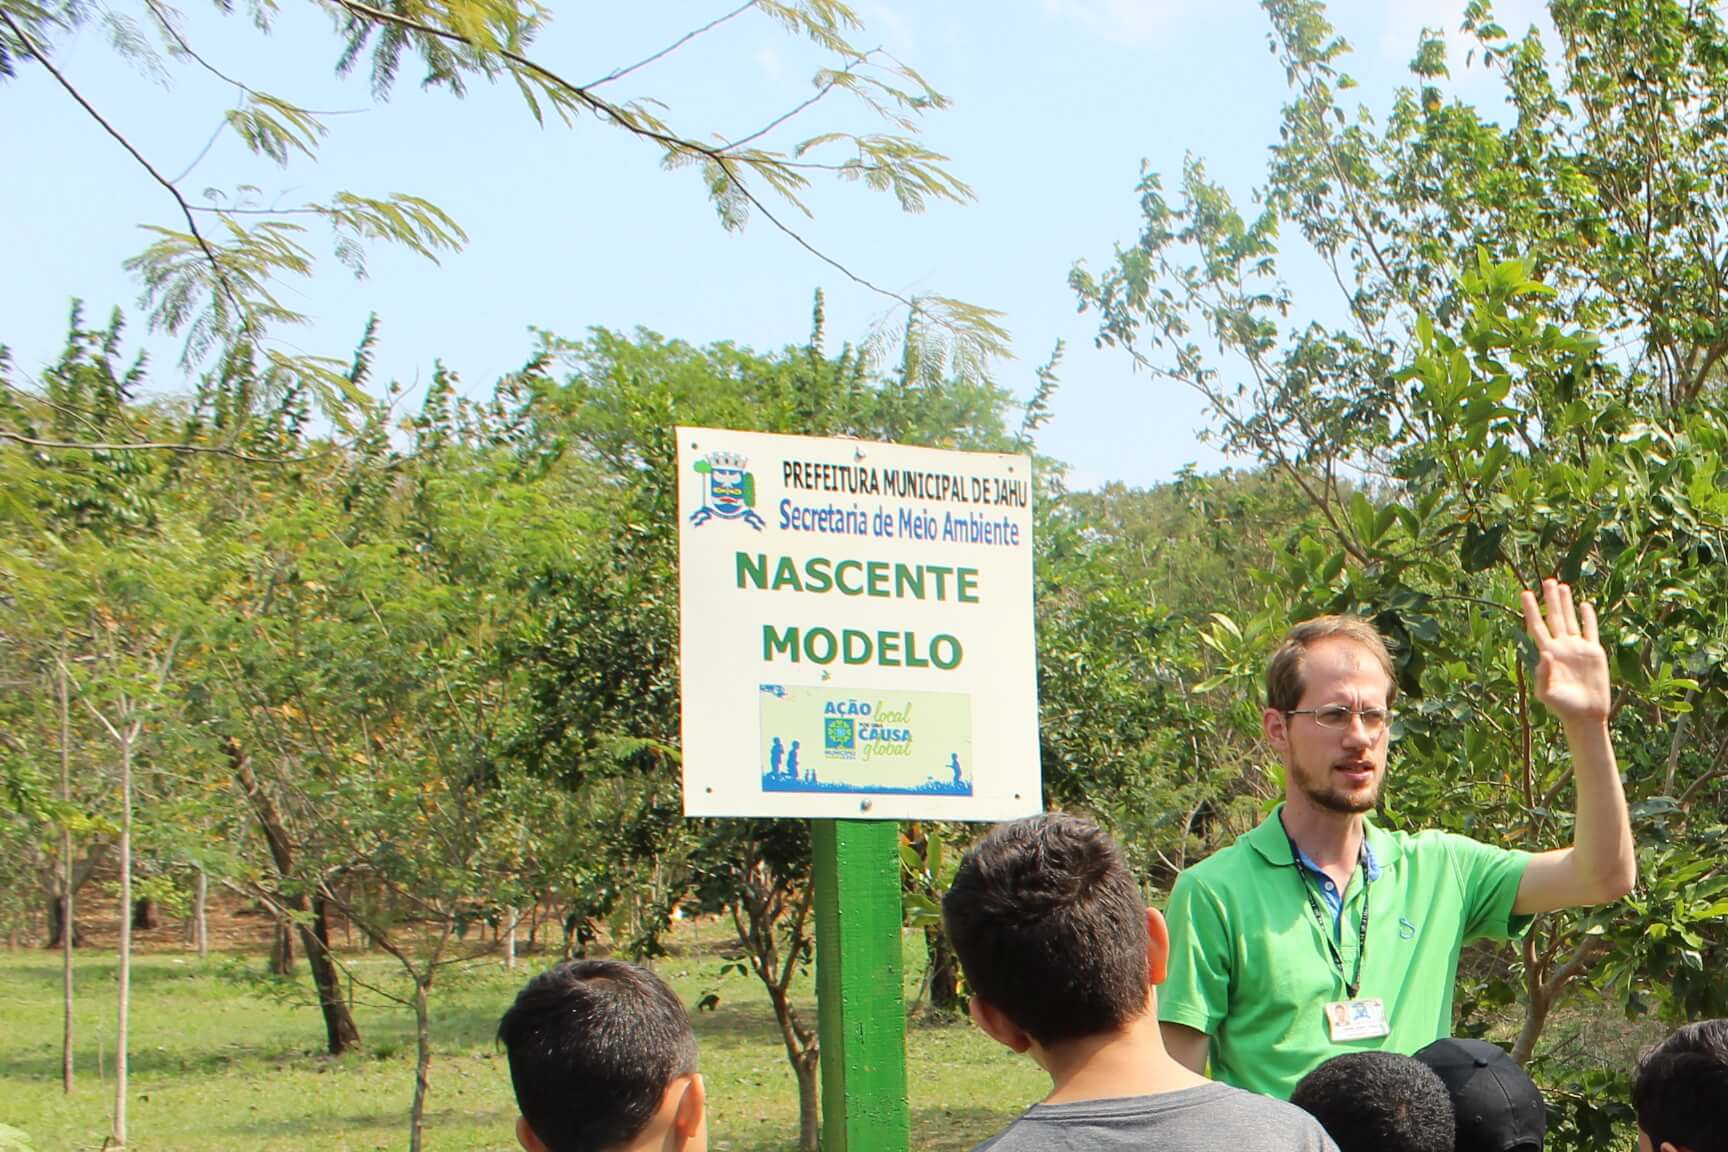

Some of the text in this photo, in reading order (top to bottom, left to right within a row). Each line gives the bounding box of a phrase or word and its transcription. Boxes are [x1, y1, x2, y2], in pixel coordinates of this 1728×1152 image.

[783, 460, 1028, 507] PREFEITURA MUNICIPAL DE JAHU
[779, 498, 1020, 546] Secretaria de Meio Ambiente
[736, 551, 980, 603] NASCENTE
[762, 624, 964, 670] MODELO
[824, 699, 912, 723] AÇÃO local
[858, 728, 911, 741] CAUSA
[863, 737, 912, 761] global
